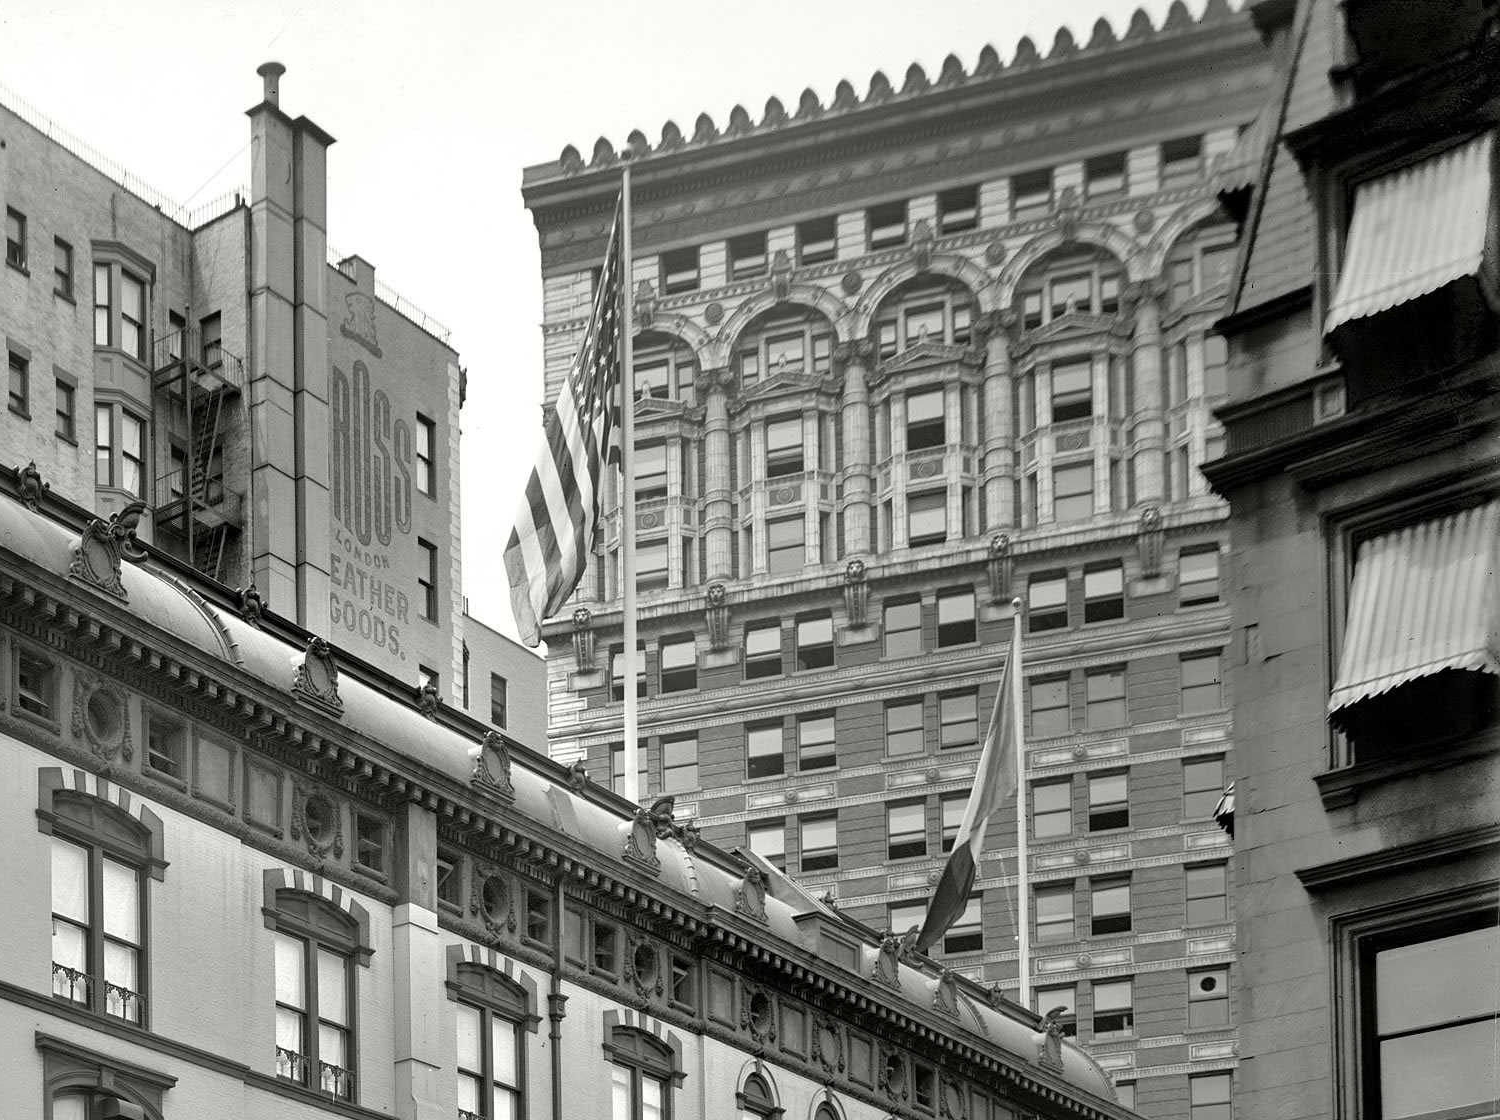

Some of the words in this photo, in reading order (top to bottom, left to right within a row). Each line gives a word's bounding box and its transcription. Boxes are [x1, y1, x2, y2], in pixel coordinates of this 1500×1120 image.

[332, 359, 413, 547] ROSS
[335, 528, 390, 569] LONDON
[330, 552, 409, 625] EATHER
[329, 591, 406, 661] GOODS.
